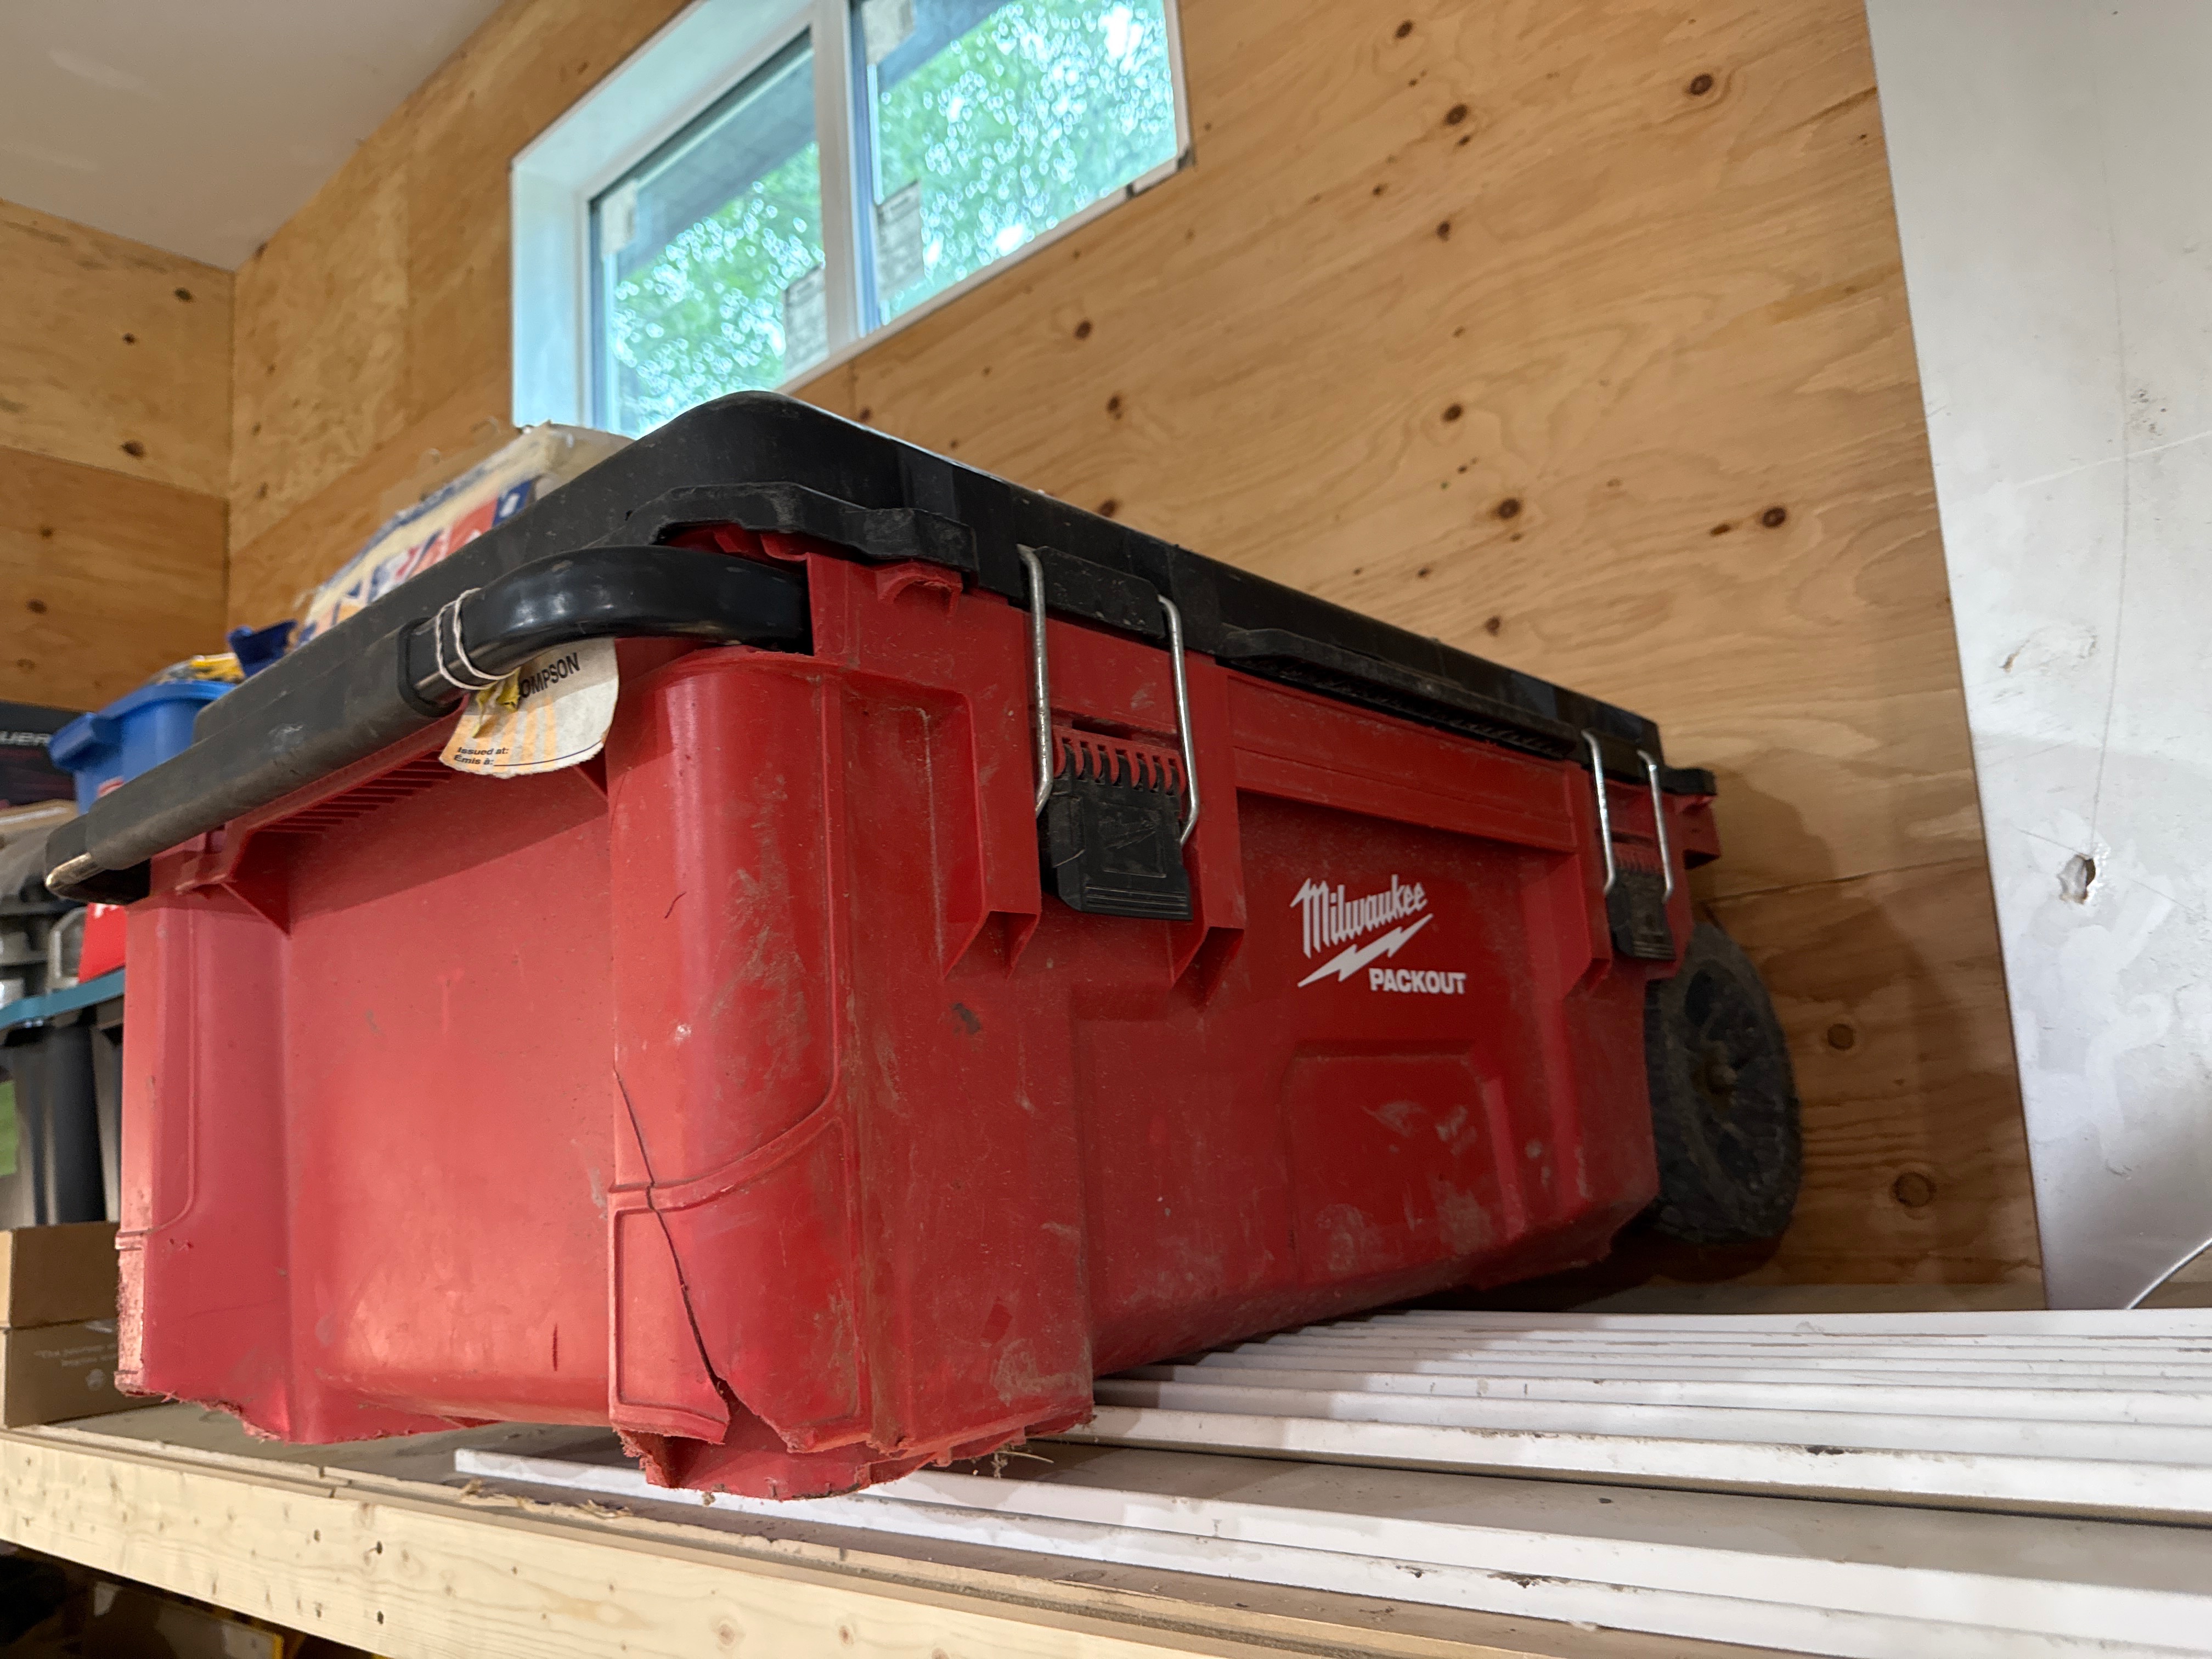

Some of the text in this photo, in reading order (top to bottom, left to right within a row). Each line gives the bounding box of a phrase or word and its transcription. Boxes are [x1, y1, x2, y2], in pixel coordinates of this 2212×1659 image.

[519, 652, 580, 698] OMPSON
[457, 747, 494, 755] Issued
[1290, 874, 1427, 959] Milwaukee
[1369, 967, 1466, 994] PACKOUT
